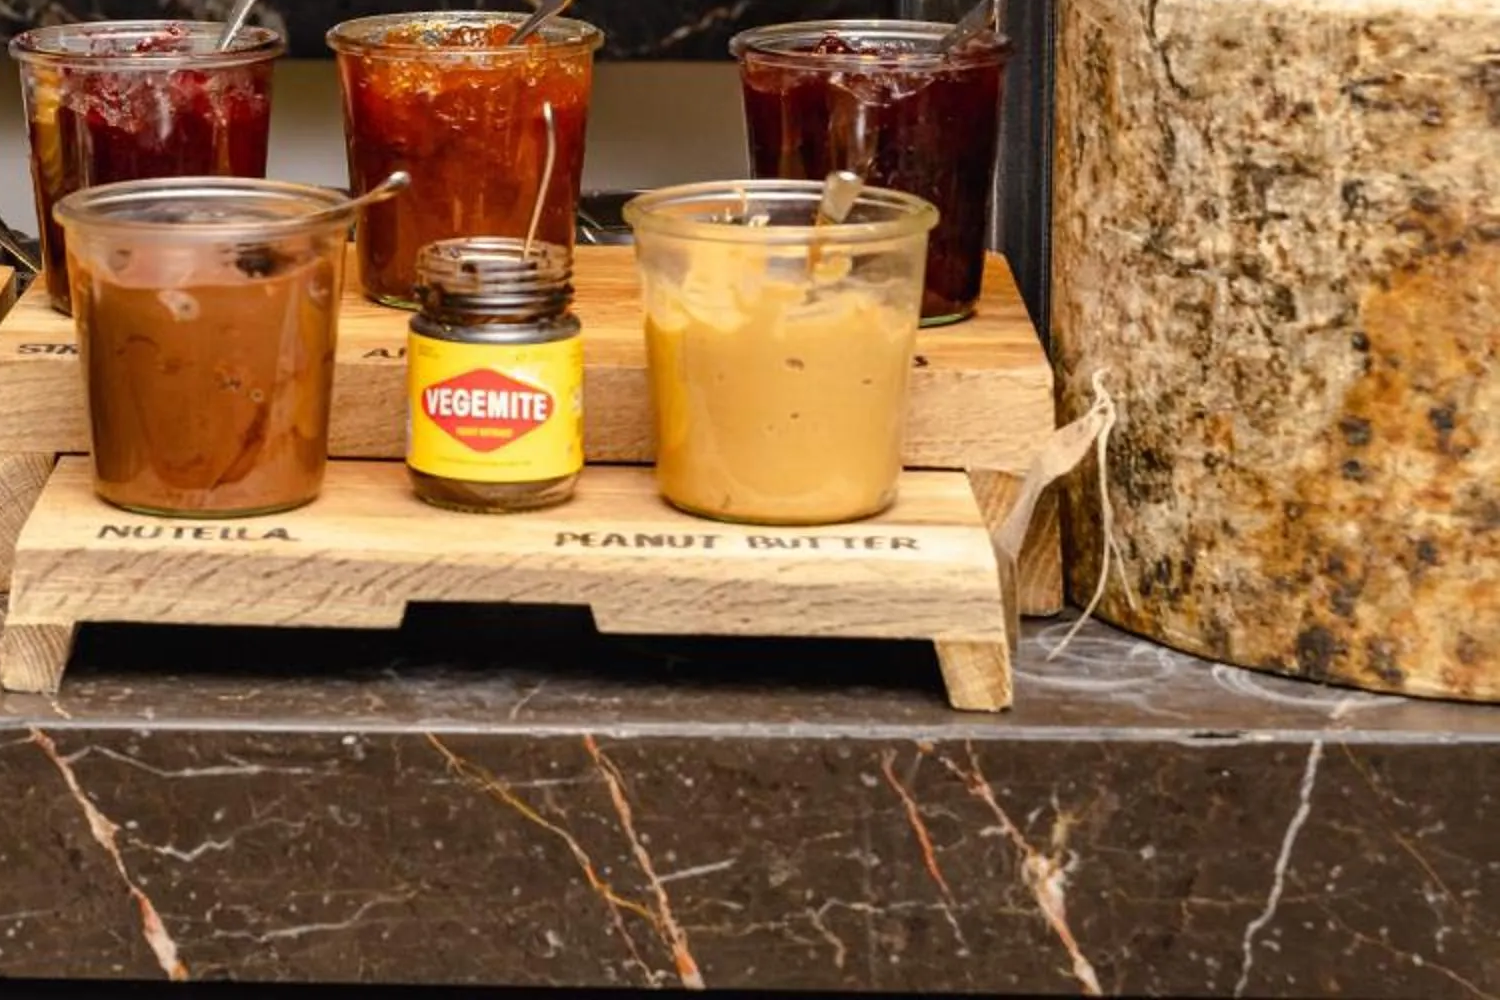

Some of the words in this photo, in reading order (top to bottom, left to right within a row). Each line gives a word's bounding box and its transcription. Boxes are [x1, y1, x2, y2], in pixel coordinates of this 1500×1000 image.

[426, 388, 548, 421] VEGEMITE
[96, 524, 301, 542] NUTELLA
[554, 531, 721, 549] PEANUT
[747, 534, 921, 551] BUTTER
